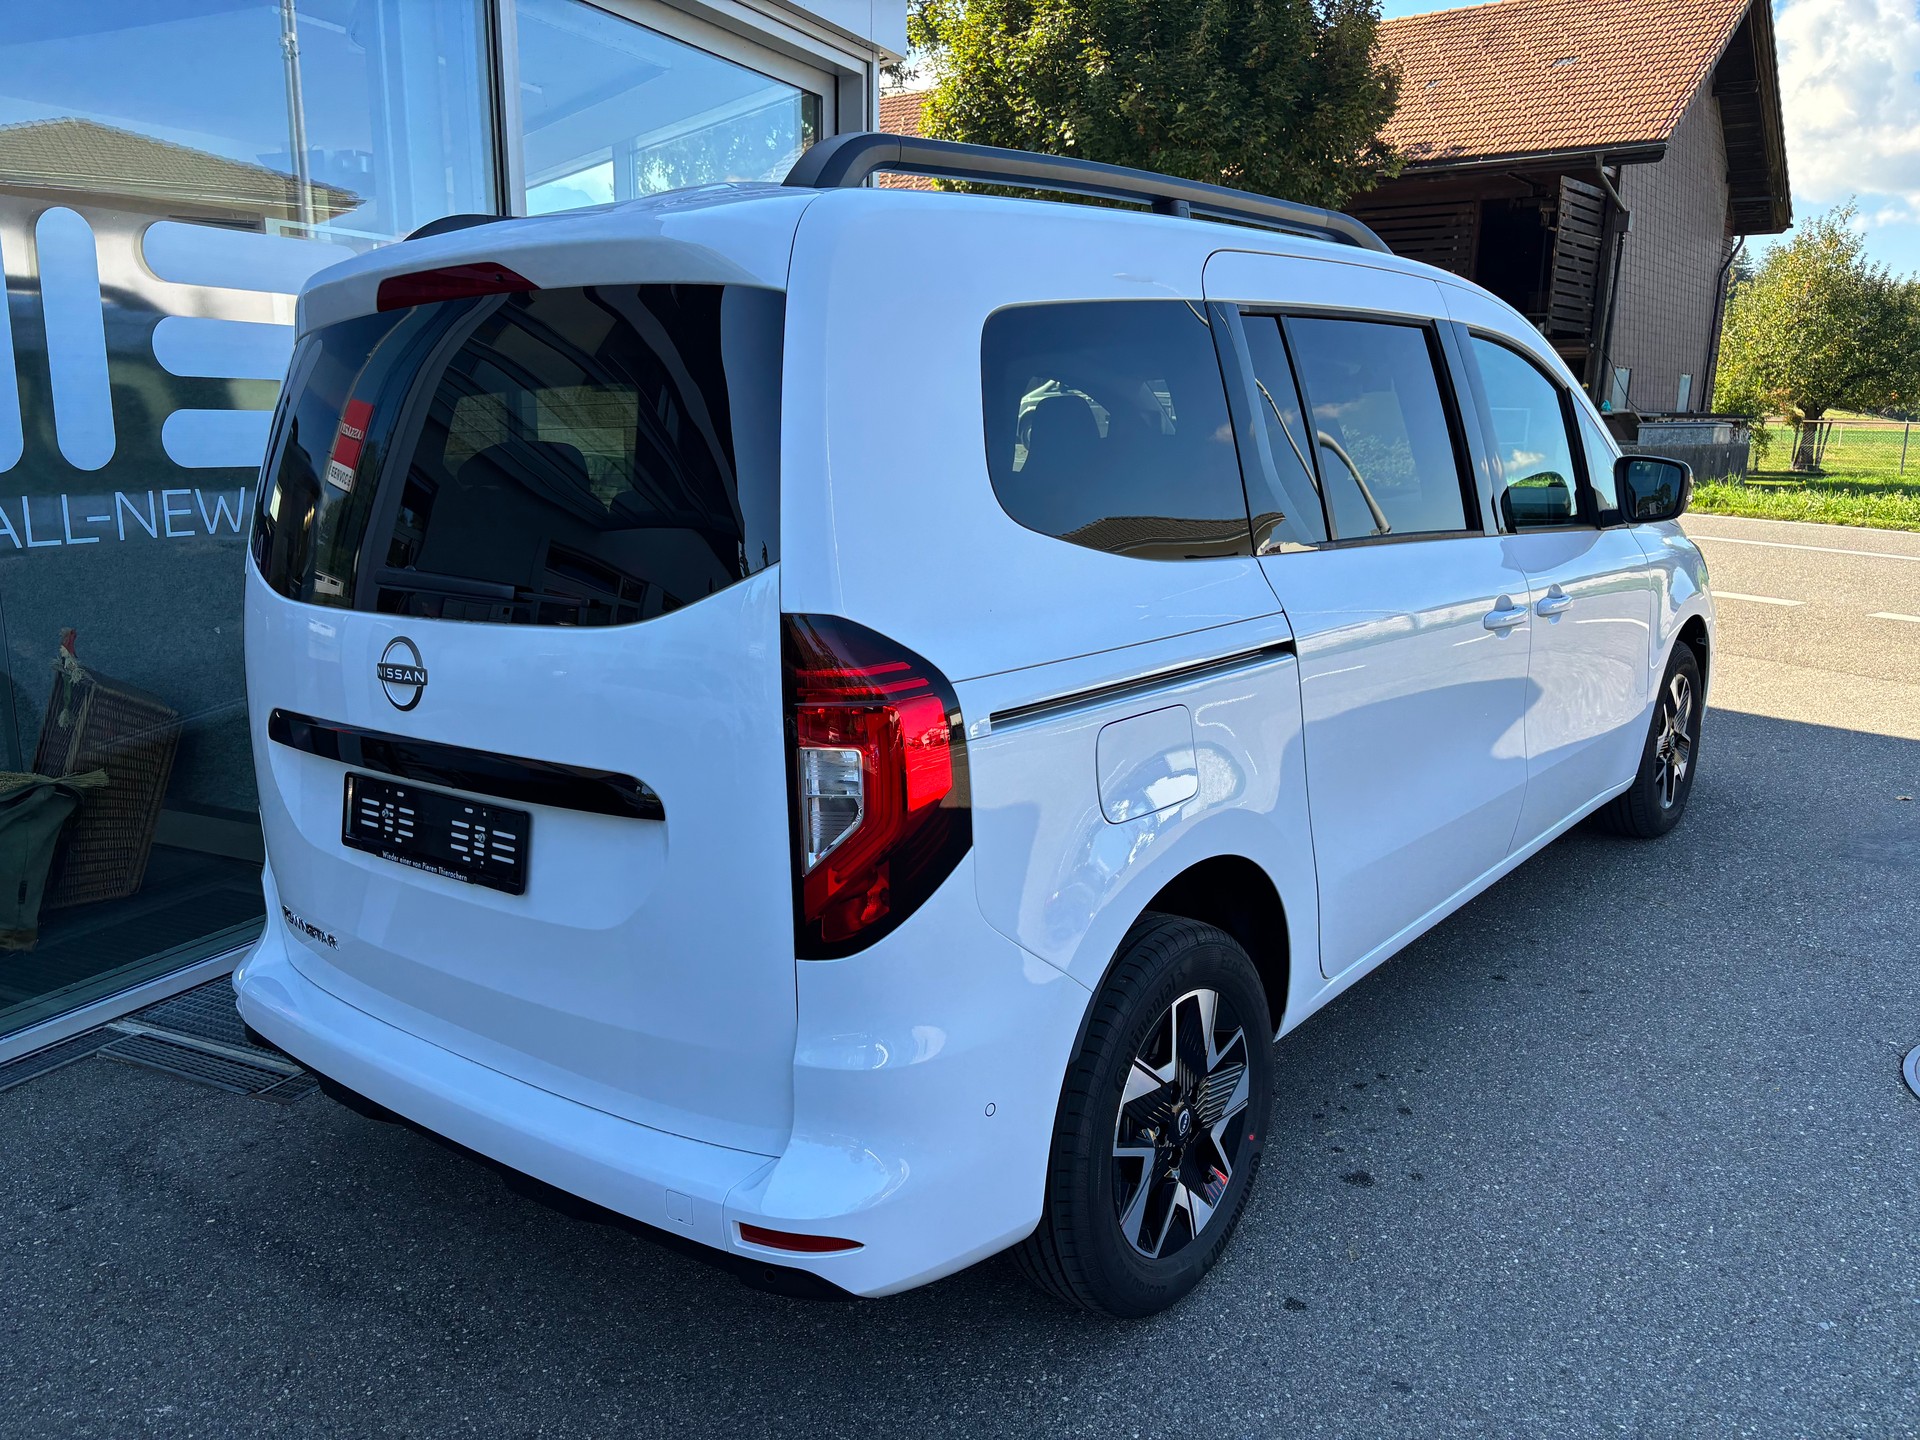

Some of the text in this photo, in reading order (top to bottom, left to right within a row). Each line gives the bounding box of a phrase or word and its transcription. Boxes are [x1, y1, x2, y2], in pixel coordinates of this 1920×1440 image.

[377, 665, 425, 683] NISSAN
[382, 850, 399, 861] Wieder
[399, 856, 412, 866] einer
[412, 861, 421, 869] von
